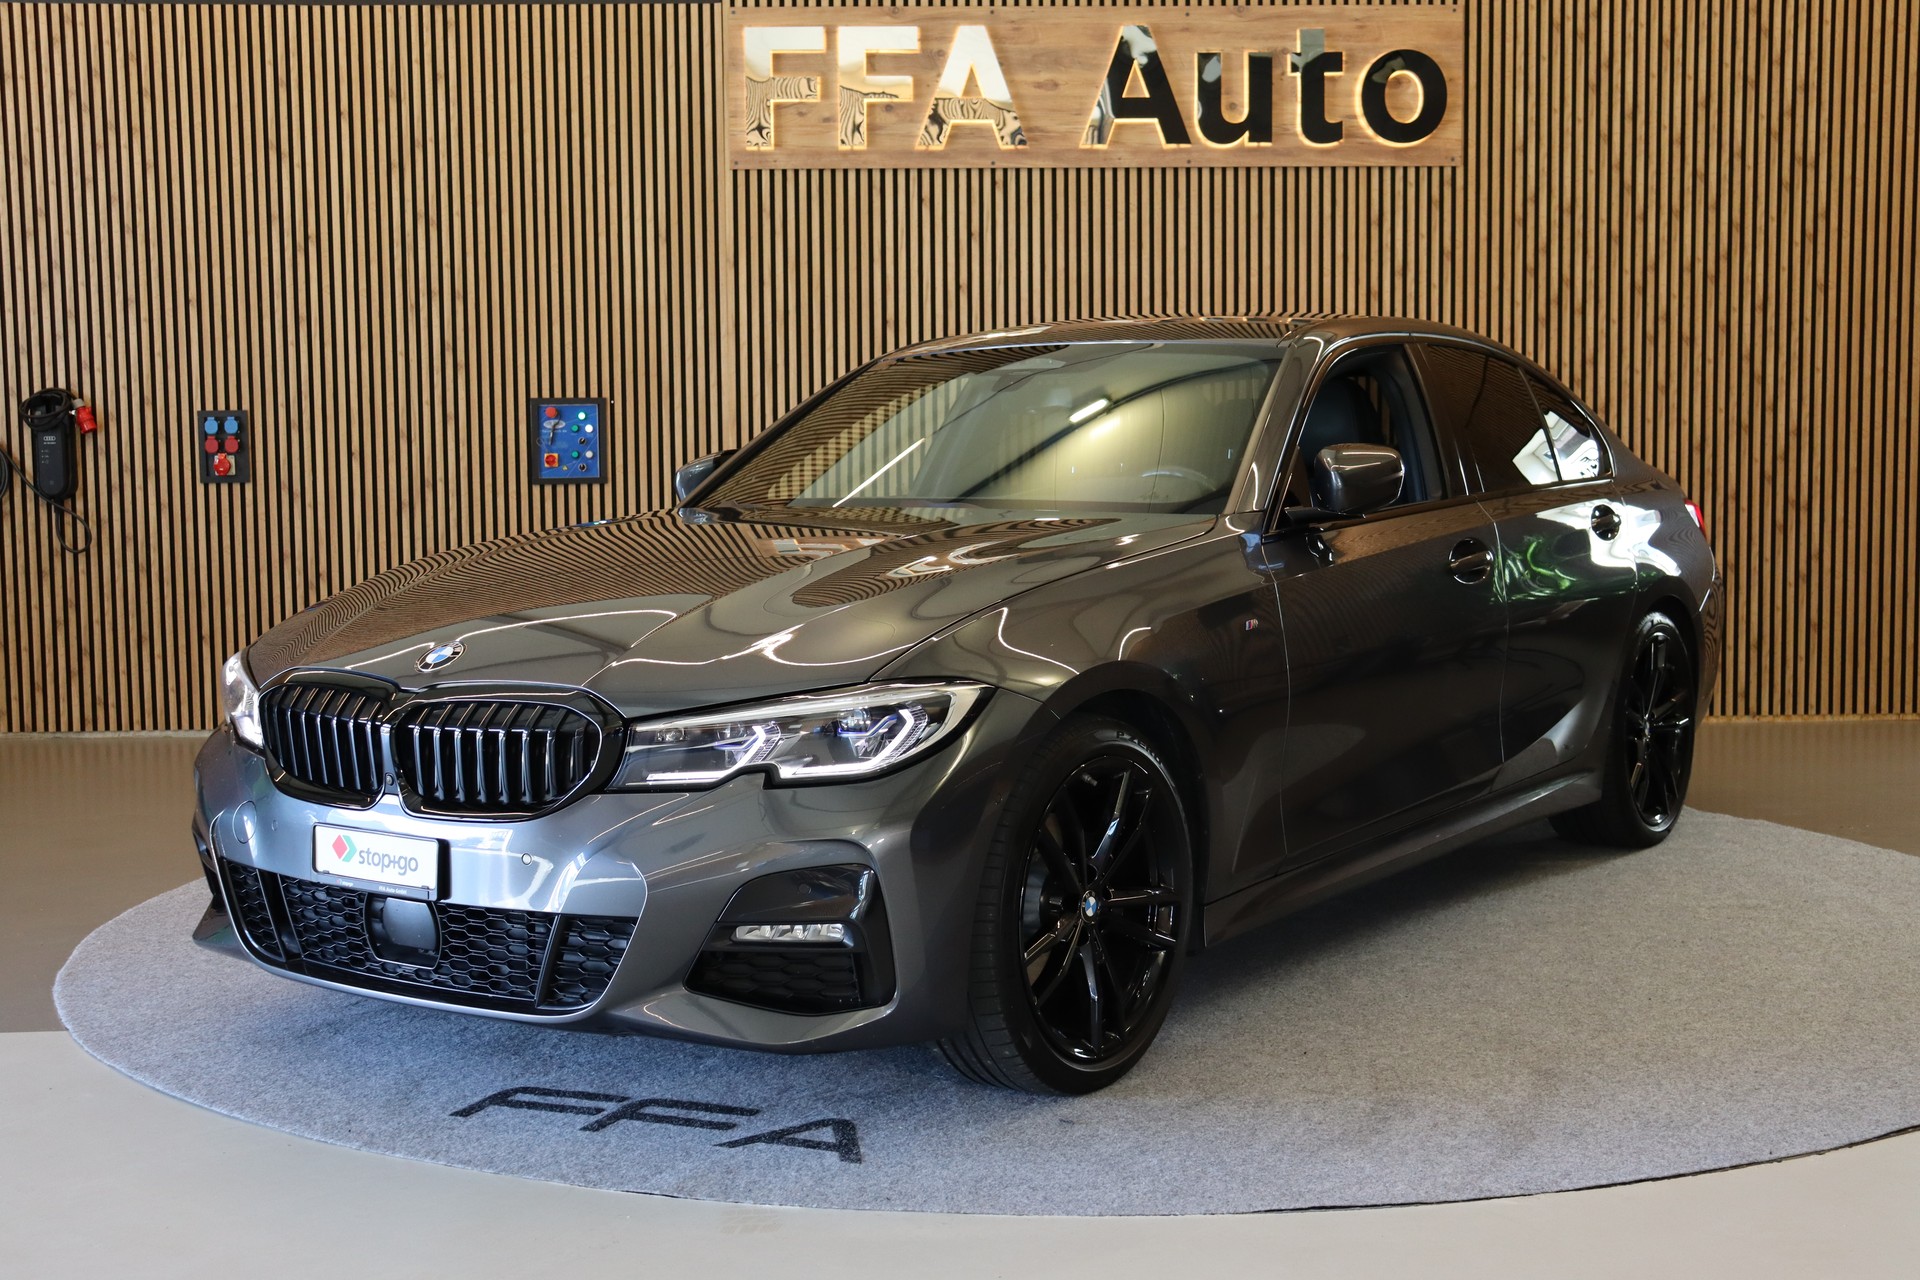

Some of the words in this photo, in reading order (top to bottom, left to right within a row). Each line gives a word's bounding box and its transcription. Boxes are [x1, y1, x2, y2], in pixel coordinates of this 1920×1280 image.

[743, 25, 1028, 149] FFA
[1080, 24, 1449, 149] Auto
[358, 847, 419, 876] stop+go
[448, 1086, 862, 1164] FFA
